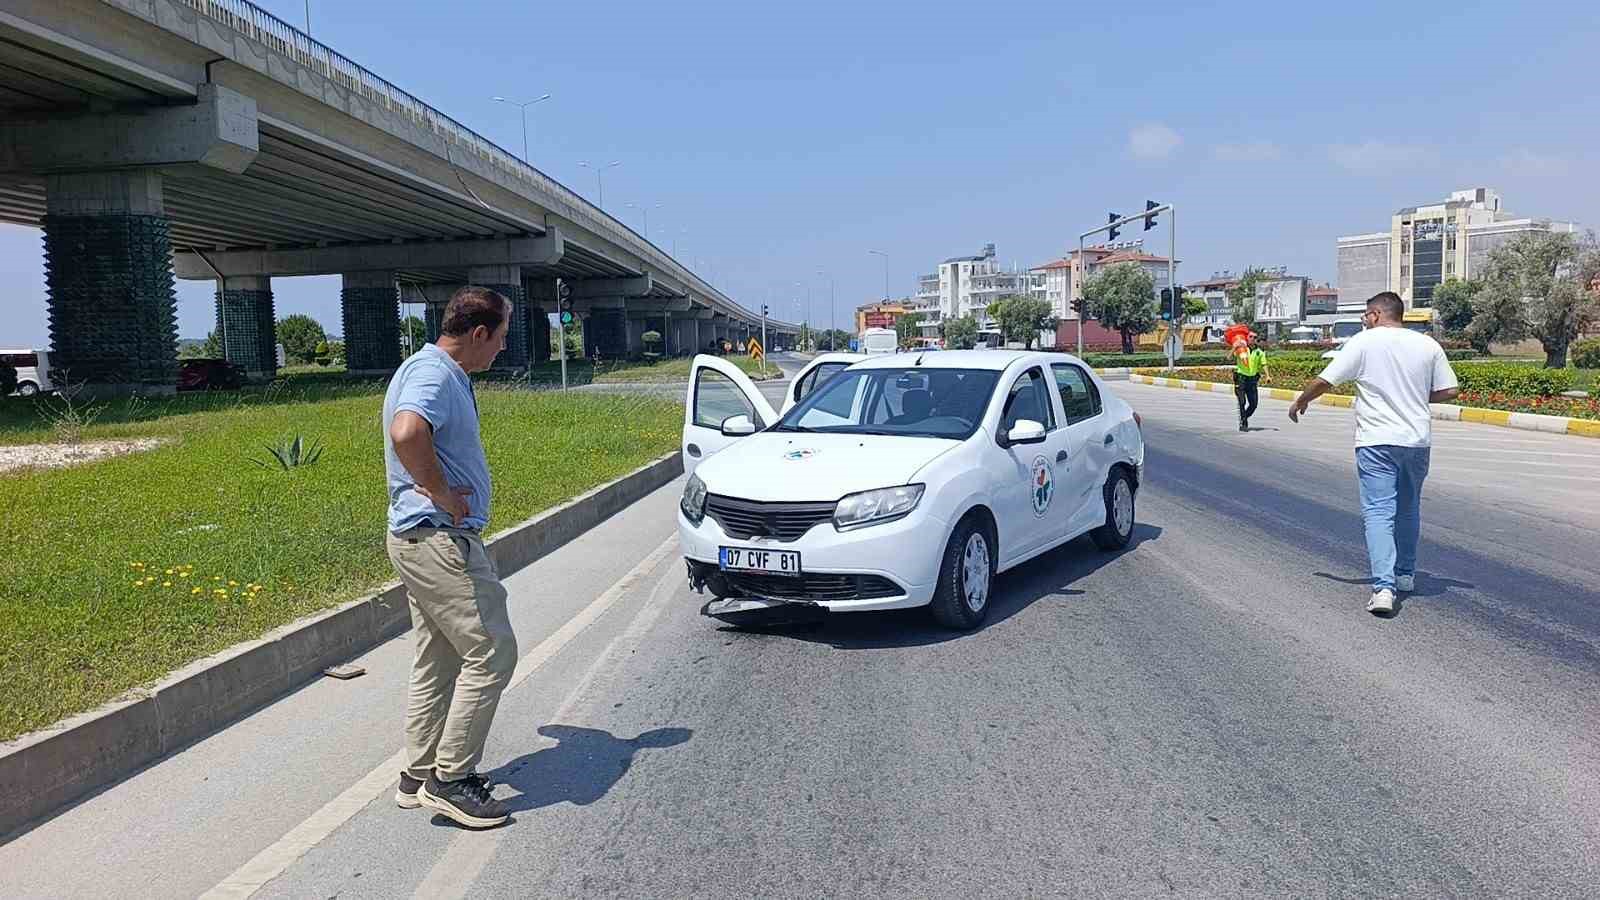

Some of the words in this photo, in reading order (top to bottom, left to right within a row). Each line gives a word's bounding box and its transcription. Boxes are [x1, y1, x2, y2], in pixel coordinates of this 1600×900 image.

[727, 550, 741, 566] 07
[748, 551, 769, 569] CVF
[781, 554, 795, 571] 81
